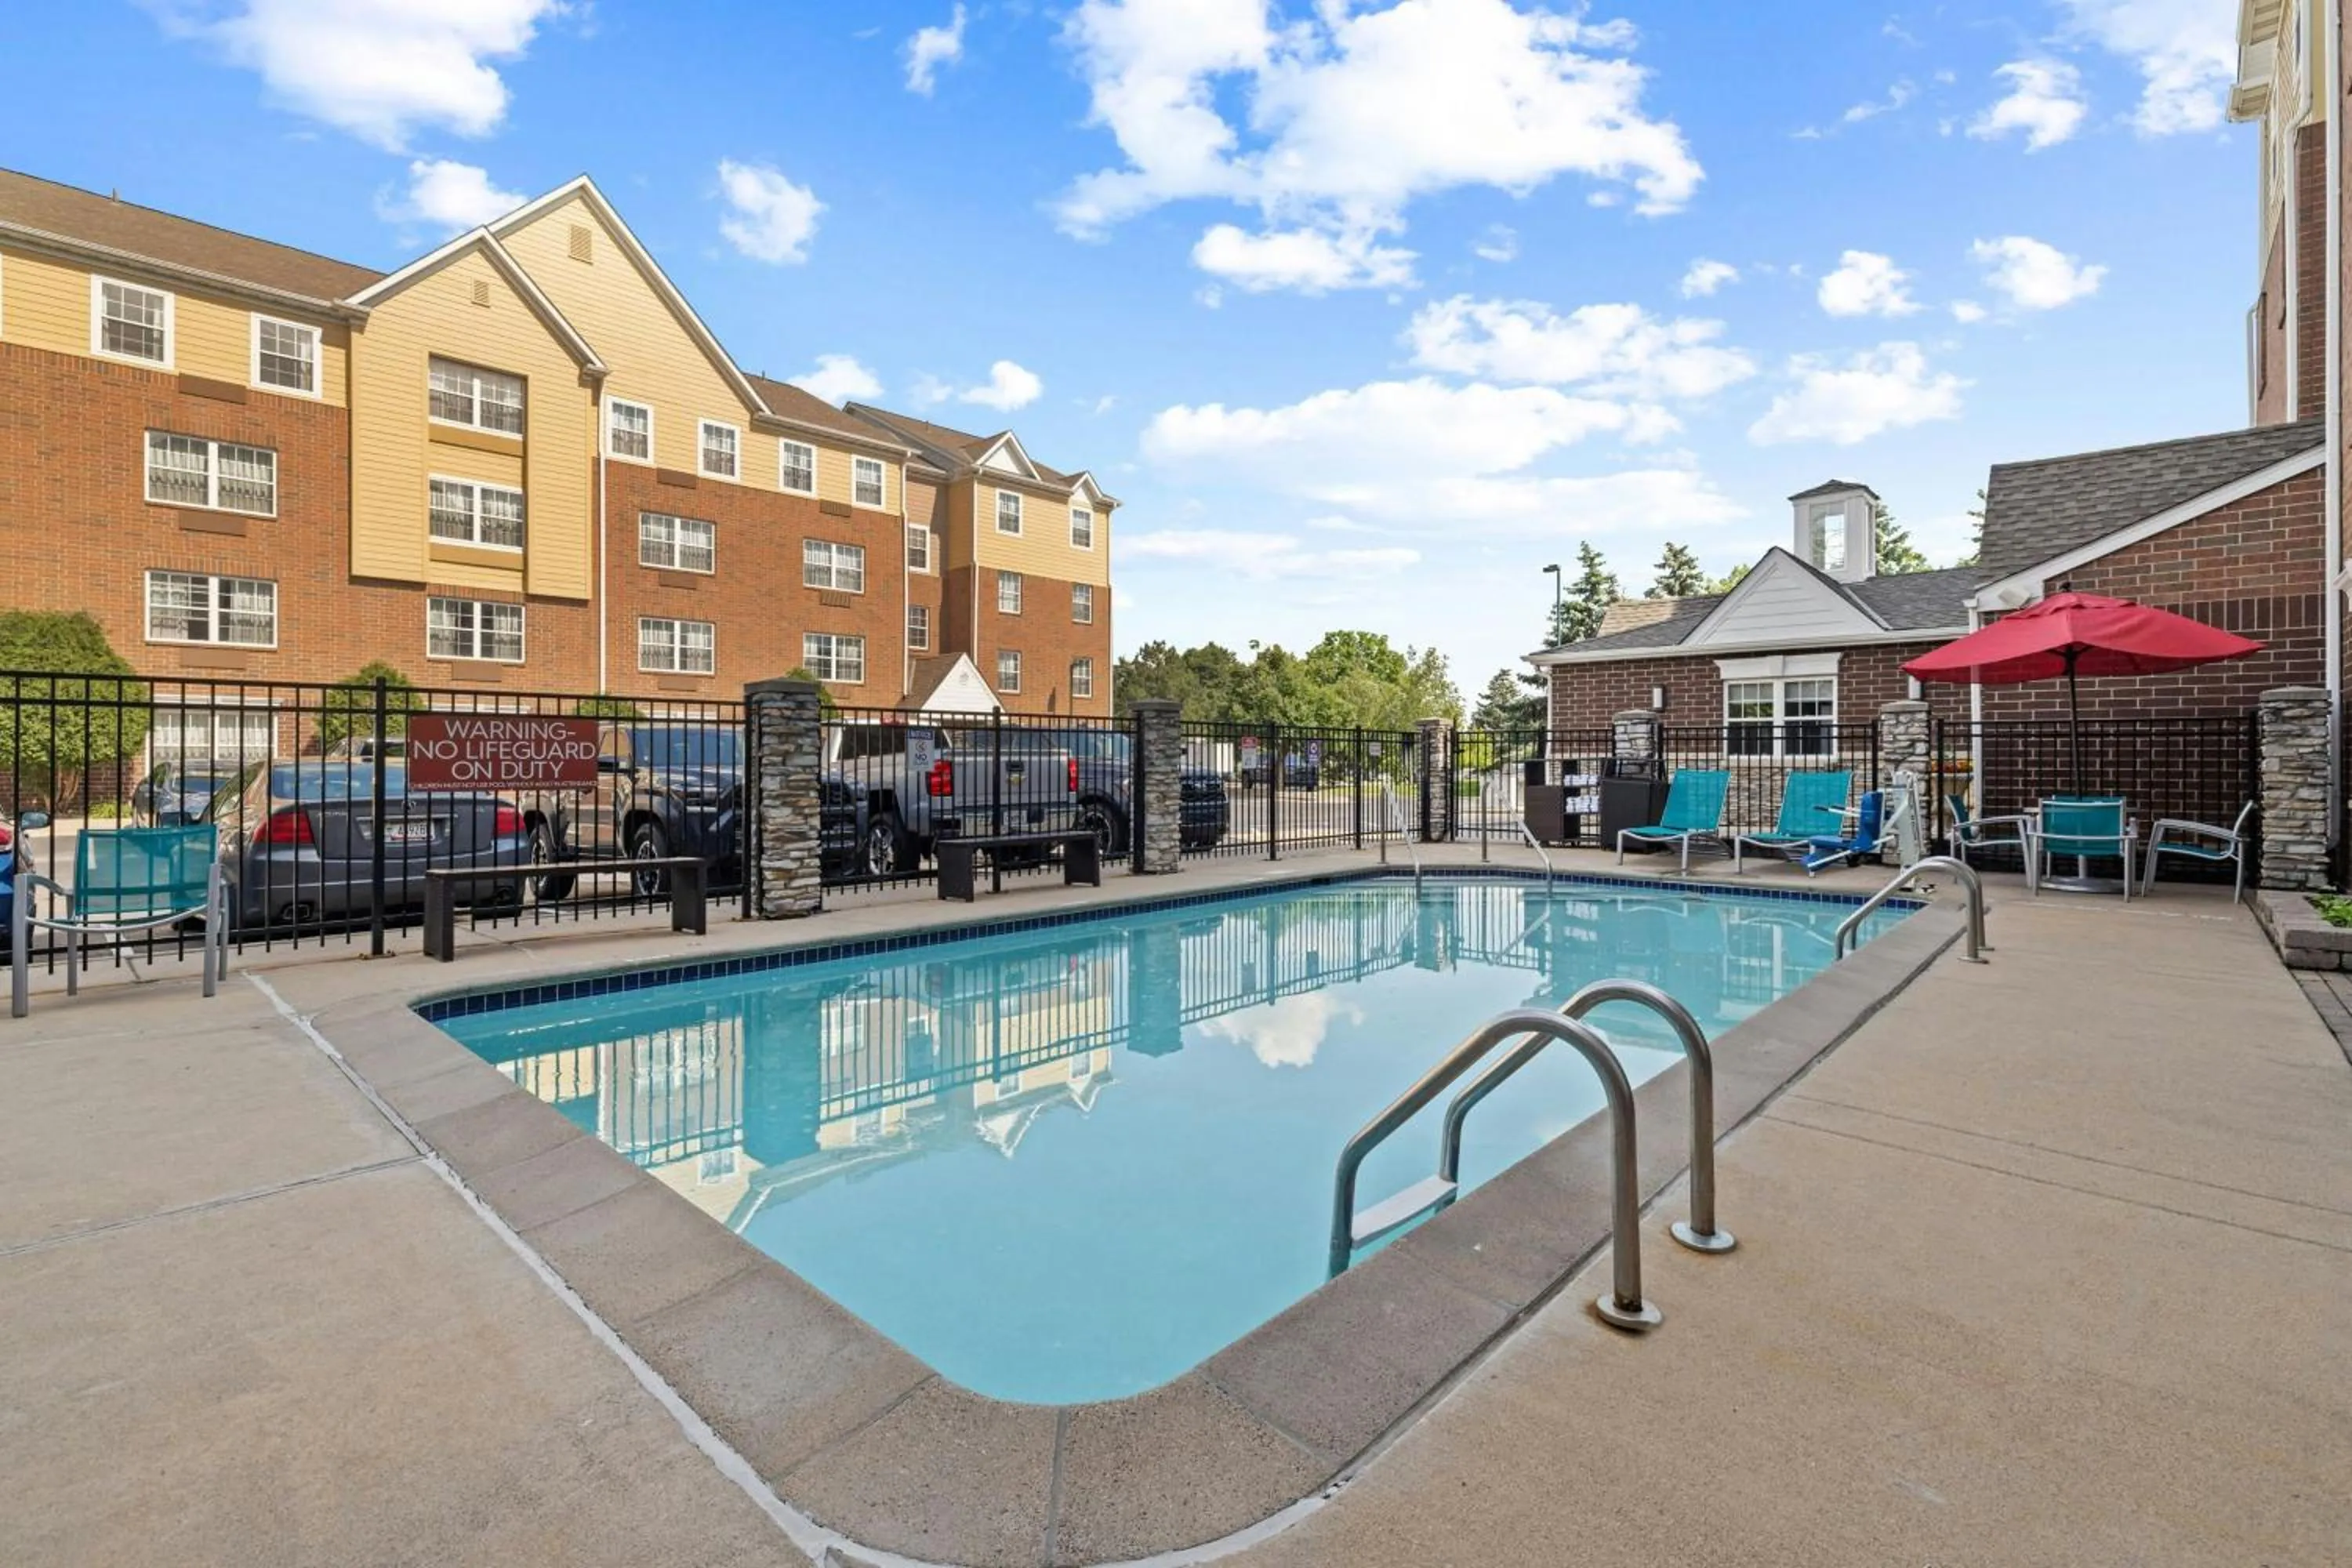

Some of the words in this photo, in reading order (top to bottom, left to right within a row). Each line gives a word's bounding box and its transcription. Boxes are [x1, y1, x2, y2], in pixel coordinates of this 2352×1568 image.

[445, 720, 576, 740] WARNING-
[413, 741, 458, 760] NO
[466, 742, 596, 760] LIFEGUARD
[451, 760, 492, 780] ON
[501, 761, 564, 779] DUTY
